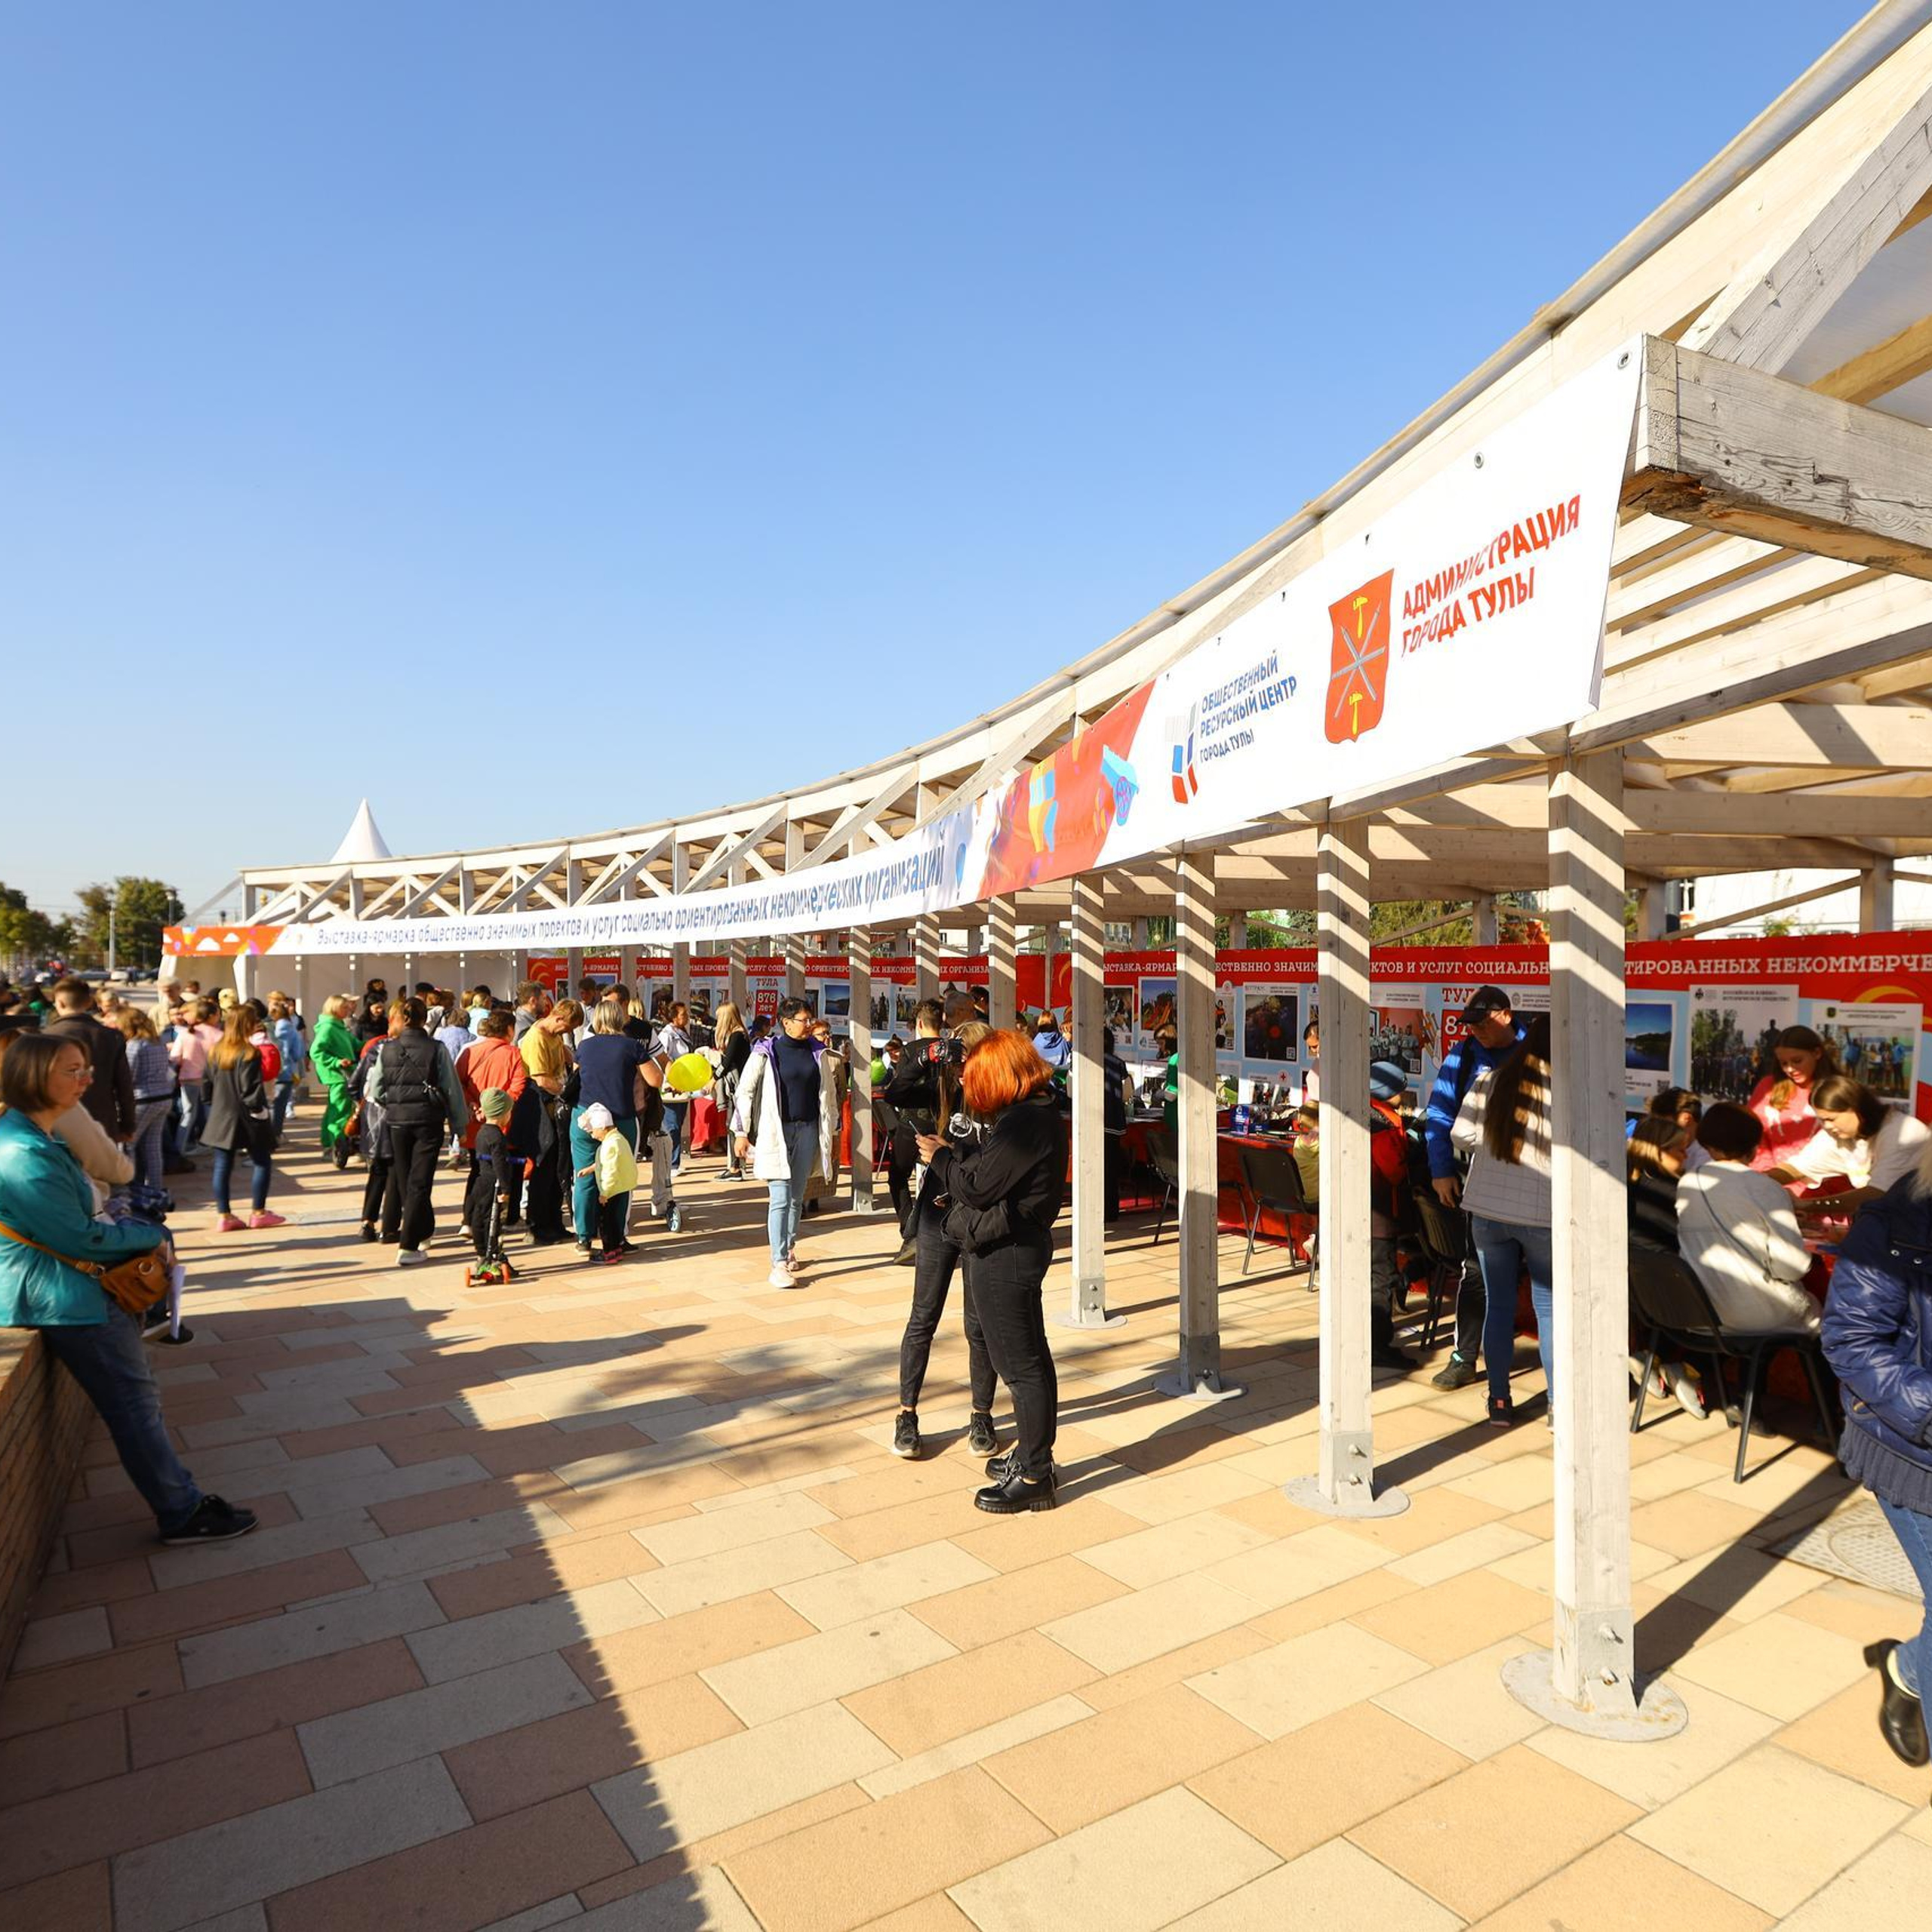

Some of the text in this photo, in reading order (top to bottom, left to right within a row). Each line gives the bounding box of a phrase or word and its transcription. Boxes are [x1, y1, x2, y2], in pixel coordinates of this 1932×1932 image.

[1402, 493, 1581, 620] АДМИНИСТРАЦИЯ
[1401, 566, 1535, 658] ГОРОДА ТУЛЫ
[1200, 675, 1298, 738] РЕСУРСНЫЙ ЦЕНТР
[1201, 649, 1278, 714] ОБЩЕСТВЕННЫЙ
[1199, 728, 1255, 764] ГОРОДА ТУЛЫ
[418, 924, 485, 944] общественно
[487, 921, 537, 941] значимых
[539, 918, 582, 940] проектов
[583, 918, 589, 935] и
[592, 915, 620, 940] услуг
[621, 908, 672, 934] социально
[675, 897, 769, 934] ориентированных
[770, 875, 863, 921] некоммерческих
[865, 829, 946, 913] организаций
[756, 977, 779, 987] ТУЛА
[1215, 961, 1272, 972] ЕСТВЕННО
[1273, 961, 1318, 972] ЗНАЧИМ
[1407, 961, 1416, 974] И
[1420, 961, 1462, 974] УСЛУГ
[1466, 961, 1550, 976] СОЦИАЛЬН
[1624, 958, 1761, 975] ТИРОВАННЫХ
[1442, 987, 1475, 1003] ТУЛ
